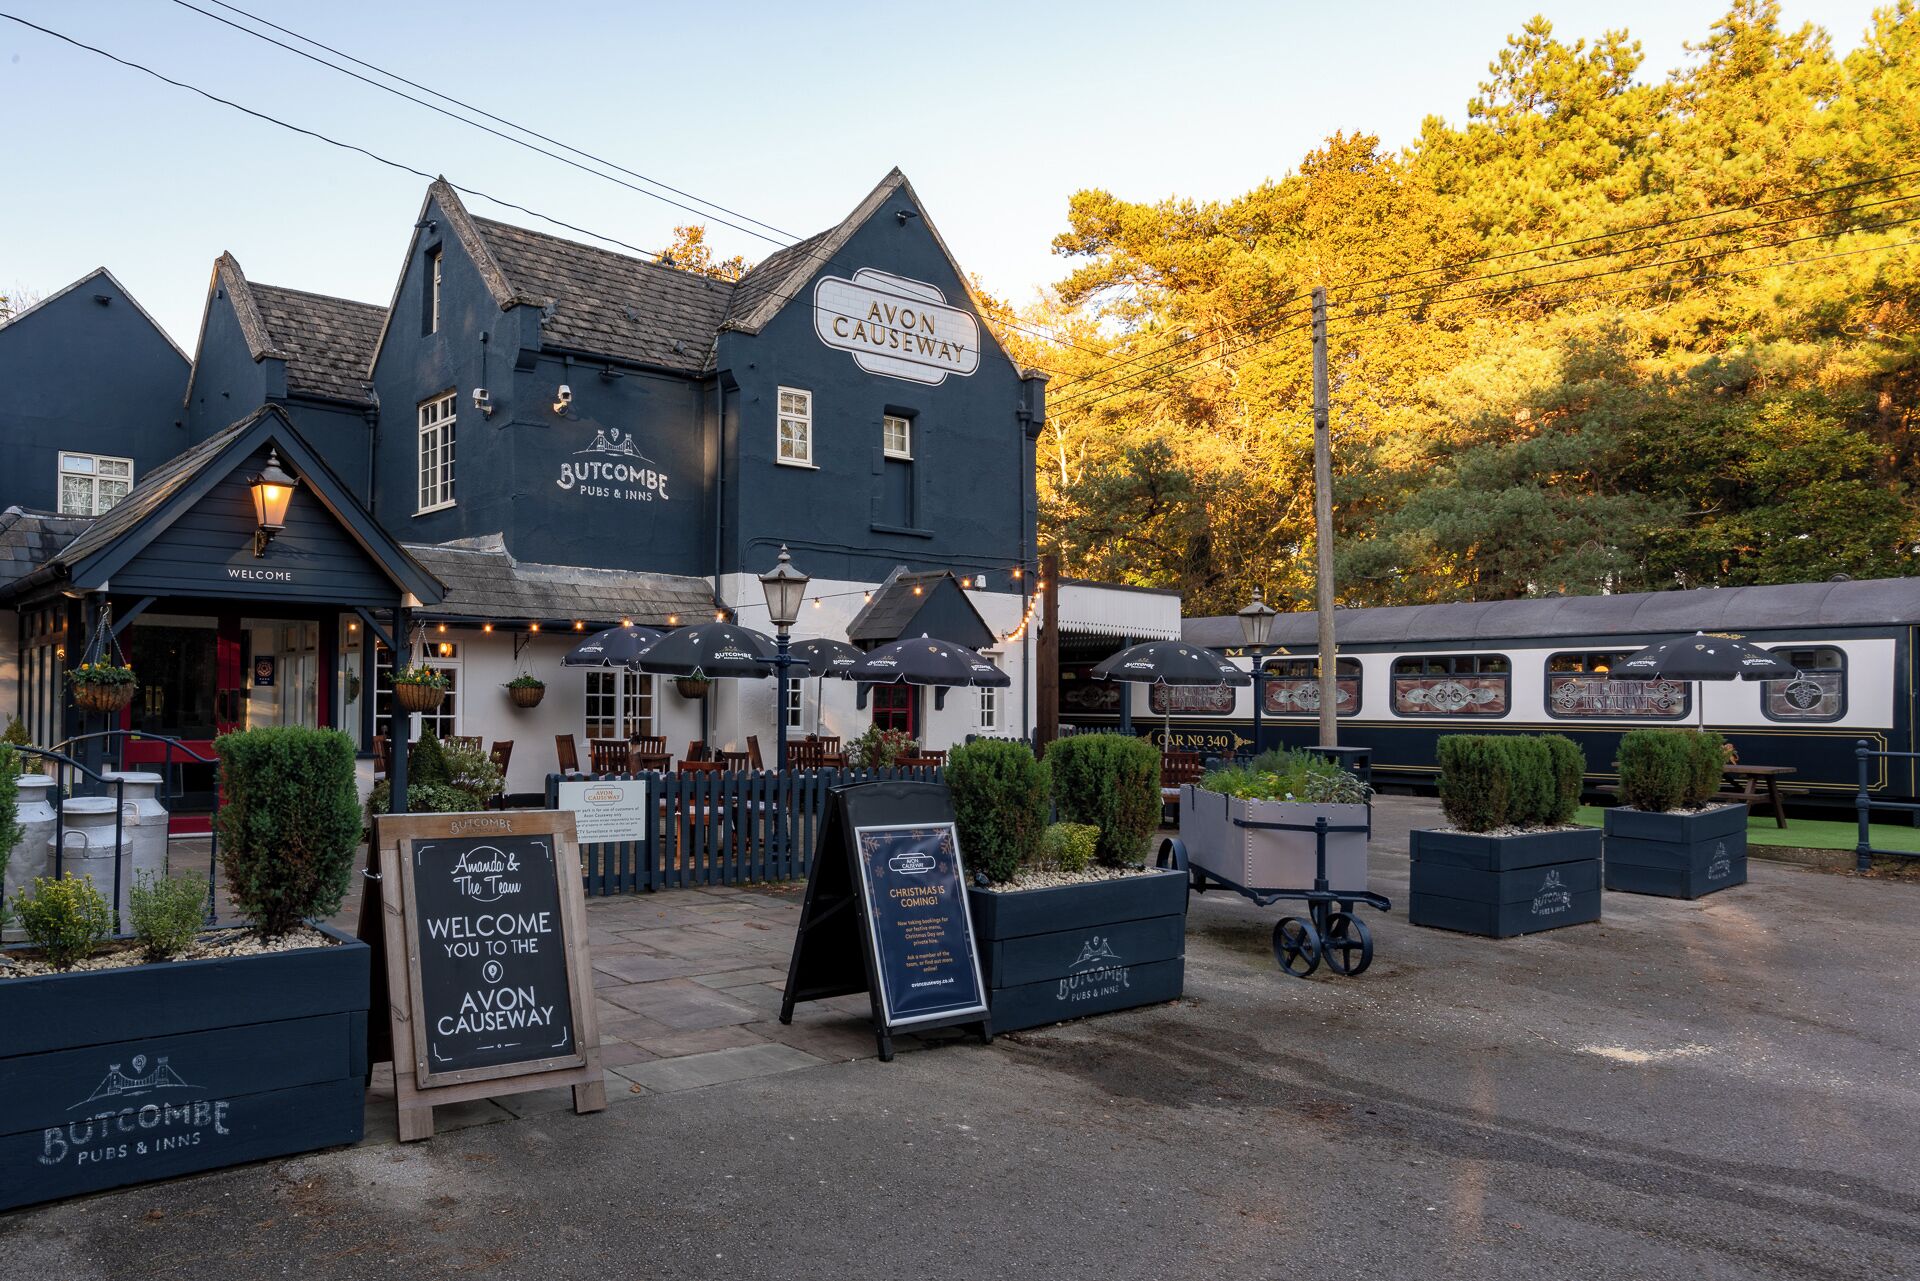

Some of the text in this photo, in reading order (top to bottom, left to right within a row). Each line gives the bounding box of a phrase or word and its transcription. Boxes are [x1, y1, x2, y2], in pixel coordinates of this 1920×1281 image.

[867, 300, 935, 335] AVON
[832, 316, 965, 363] CAUSEWAY
[556, 461, 669, 500] BUTCOMBE
[580, 485, 653, 501] PUBS & INNS
[228, 568, 291, 581] WELCOME
[1157, 733, 1184, 746] CAR
[1207, 734, 1228, 747] 340
[449, 817, 513, 835] BUTCOMBE
[450, 852, 520, 874] Amanda &
[452, 874, 521, 895] The Team
[890, 885, 945, 898] CHRISTMAS IS
[900, 896, 939, 908] COMING!
[427, 911, 552, 940] WELCOME
[904, 932, 926, 940] Christmas
[444, 938, 539, 958] YOU TO THE
[1056, 965, 1130, 1001] BUTCOMBE
[1071, 985, 1120, 1002] PUBS & INNS
[460, 985, 536, 1014] AVON
[437, 1005, 554, 1036] CAUSEWAY
[37, 1100, 231, 1166] BUTCOMBE
[78, 1131, 202, 1165] PUBS & INNS
